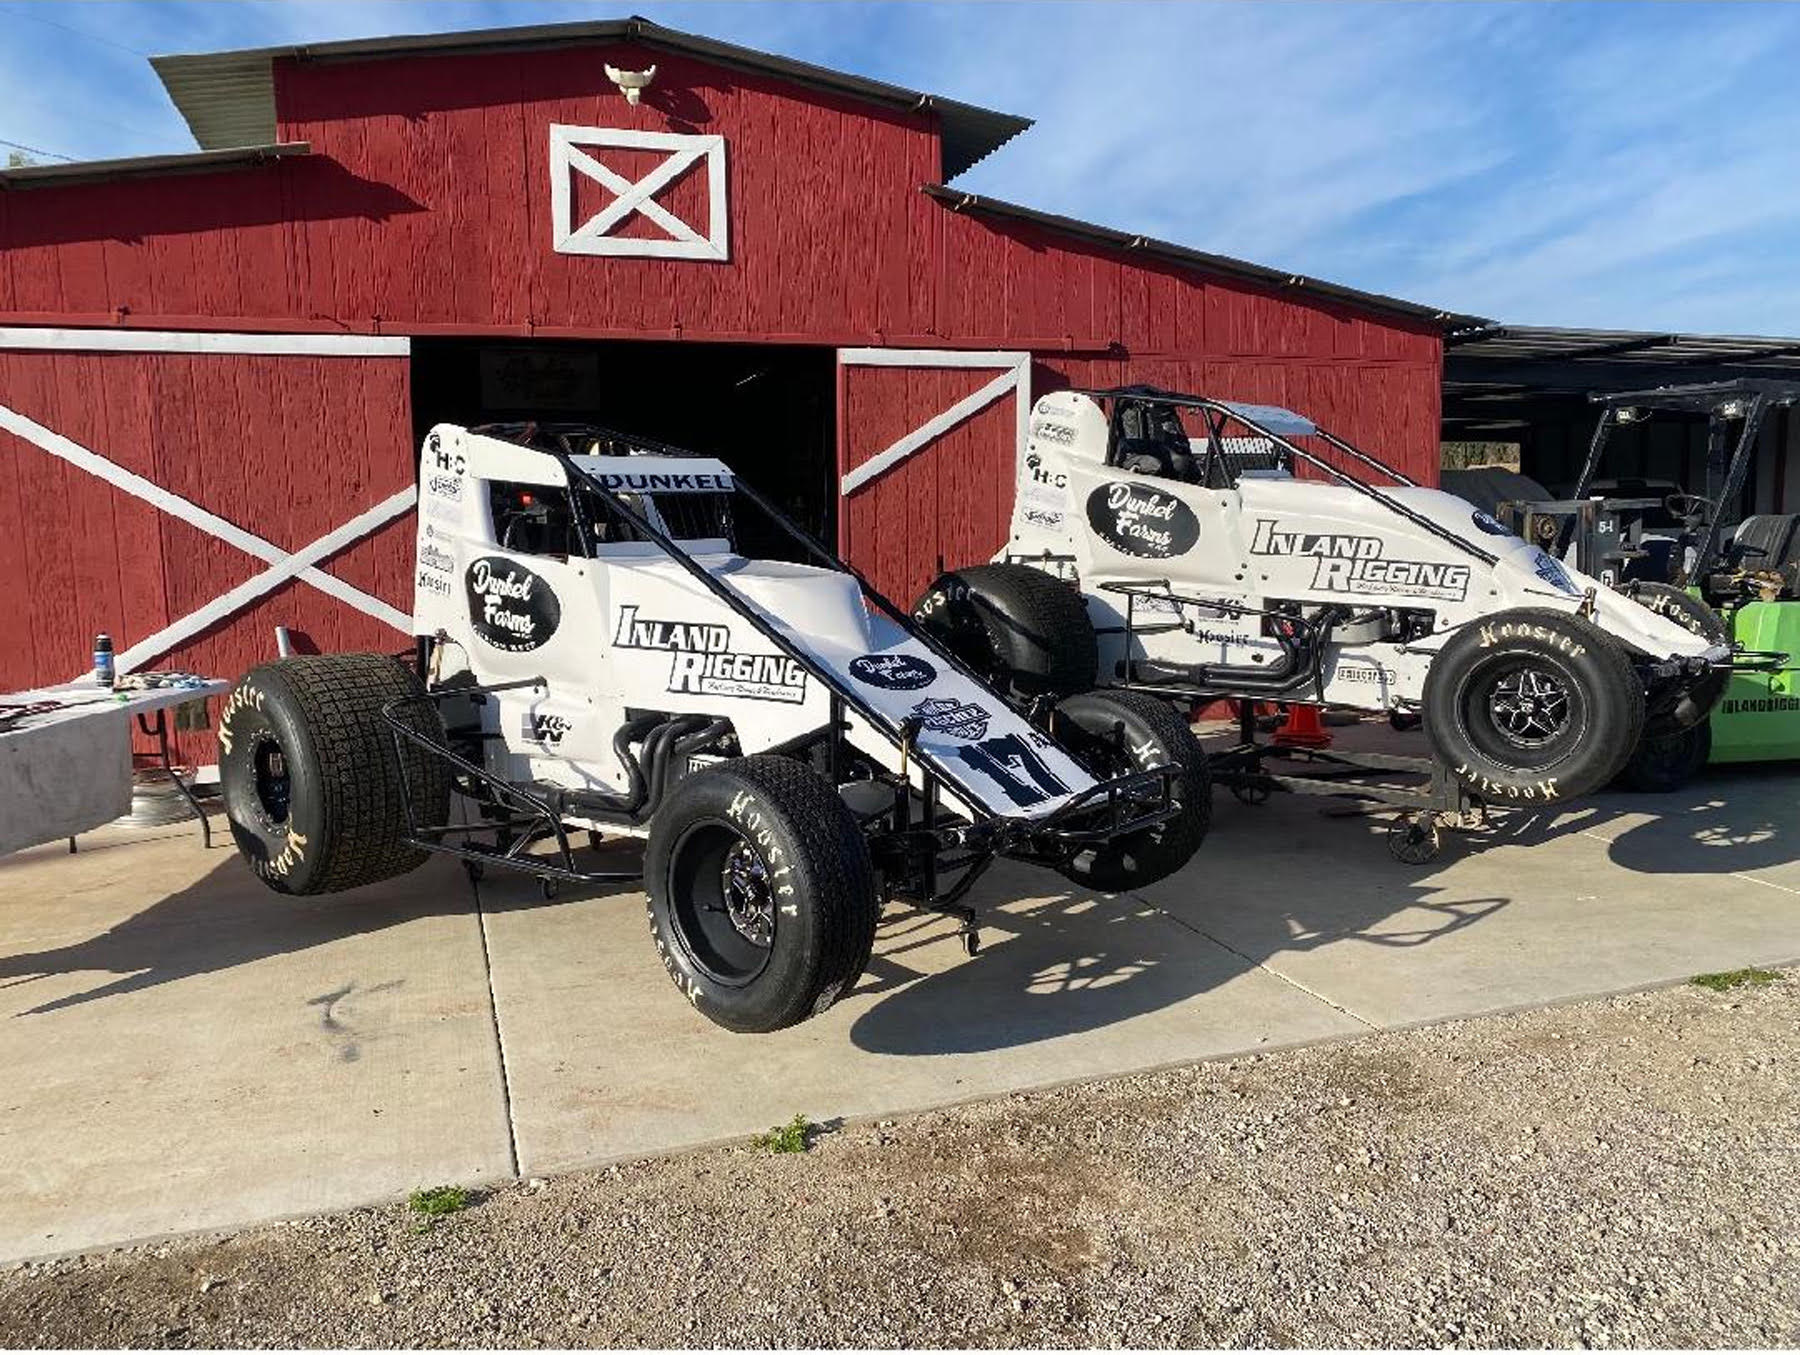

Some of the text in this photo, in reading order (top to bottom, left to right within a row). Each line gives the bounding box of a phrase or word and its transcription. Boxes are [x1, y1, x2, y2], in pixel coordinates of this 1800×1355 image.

[600, 474, 733, 488] DUNKEL
[1107, 483, 1178, 521] Dunkel
[1116, 511, 1173, 544] Farms
[472, 559, 532, 601] Dunkel
[484, 594, 535, 634] Farms
[1479, 621, 1586, 657] Hoosier
[957, 733, 1073, 808] 17
[1455, 763, 1561, 800] Hoosier
[726, 790, 798, 917] Hoosier
